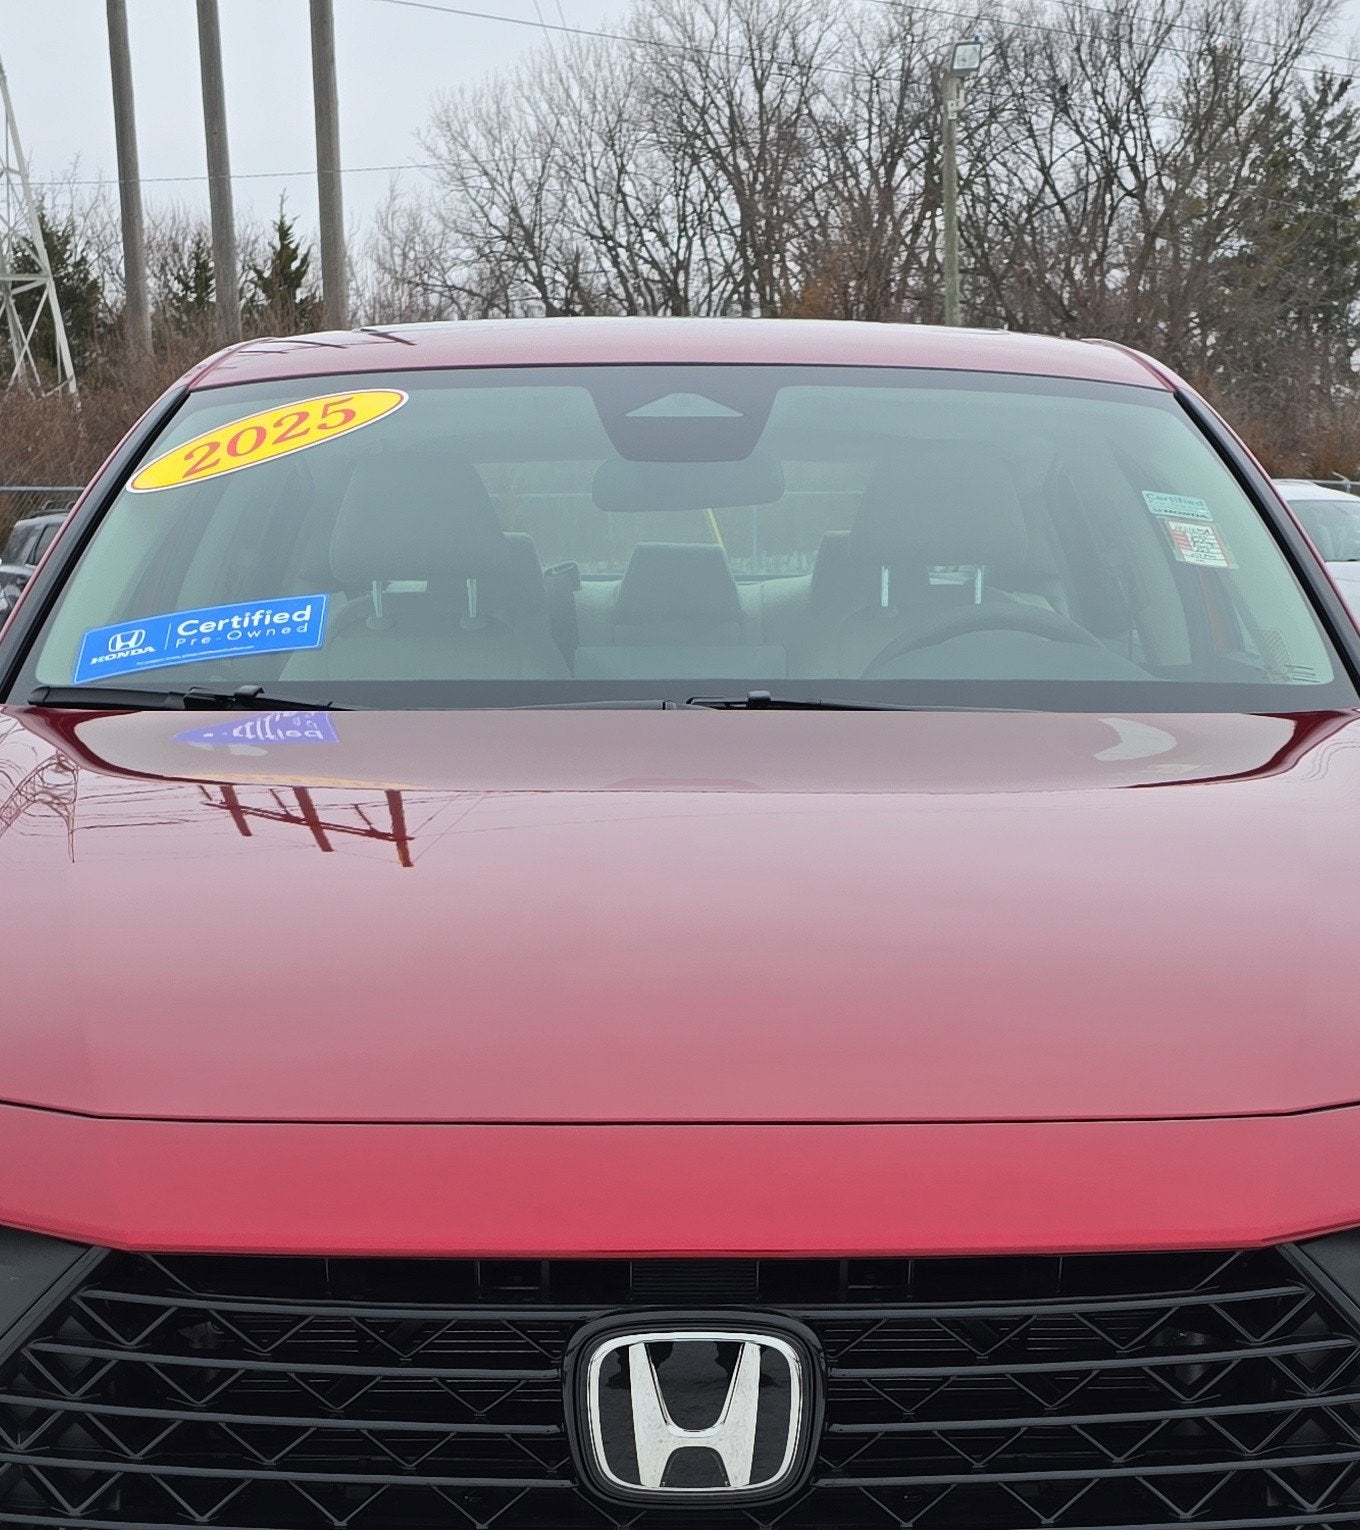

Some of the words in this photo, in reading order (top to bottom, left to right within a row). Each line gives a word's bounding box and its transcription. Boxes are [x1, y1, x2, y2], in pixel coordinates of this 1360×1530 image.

[181, 396, 357, 479] 2025
[177, 604, 312, 636] Certified
[175, 622, 309, 649] Pre-Owned
[90, 645, 156, 665] HONDA
